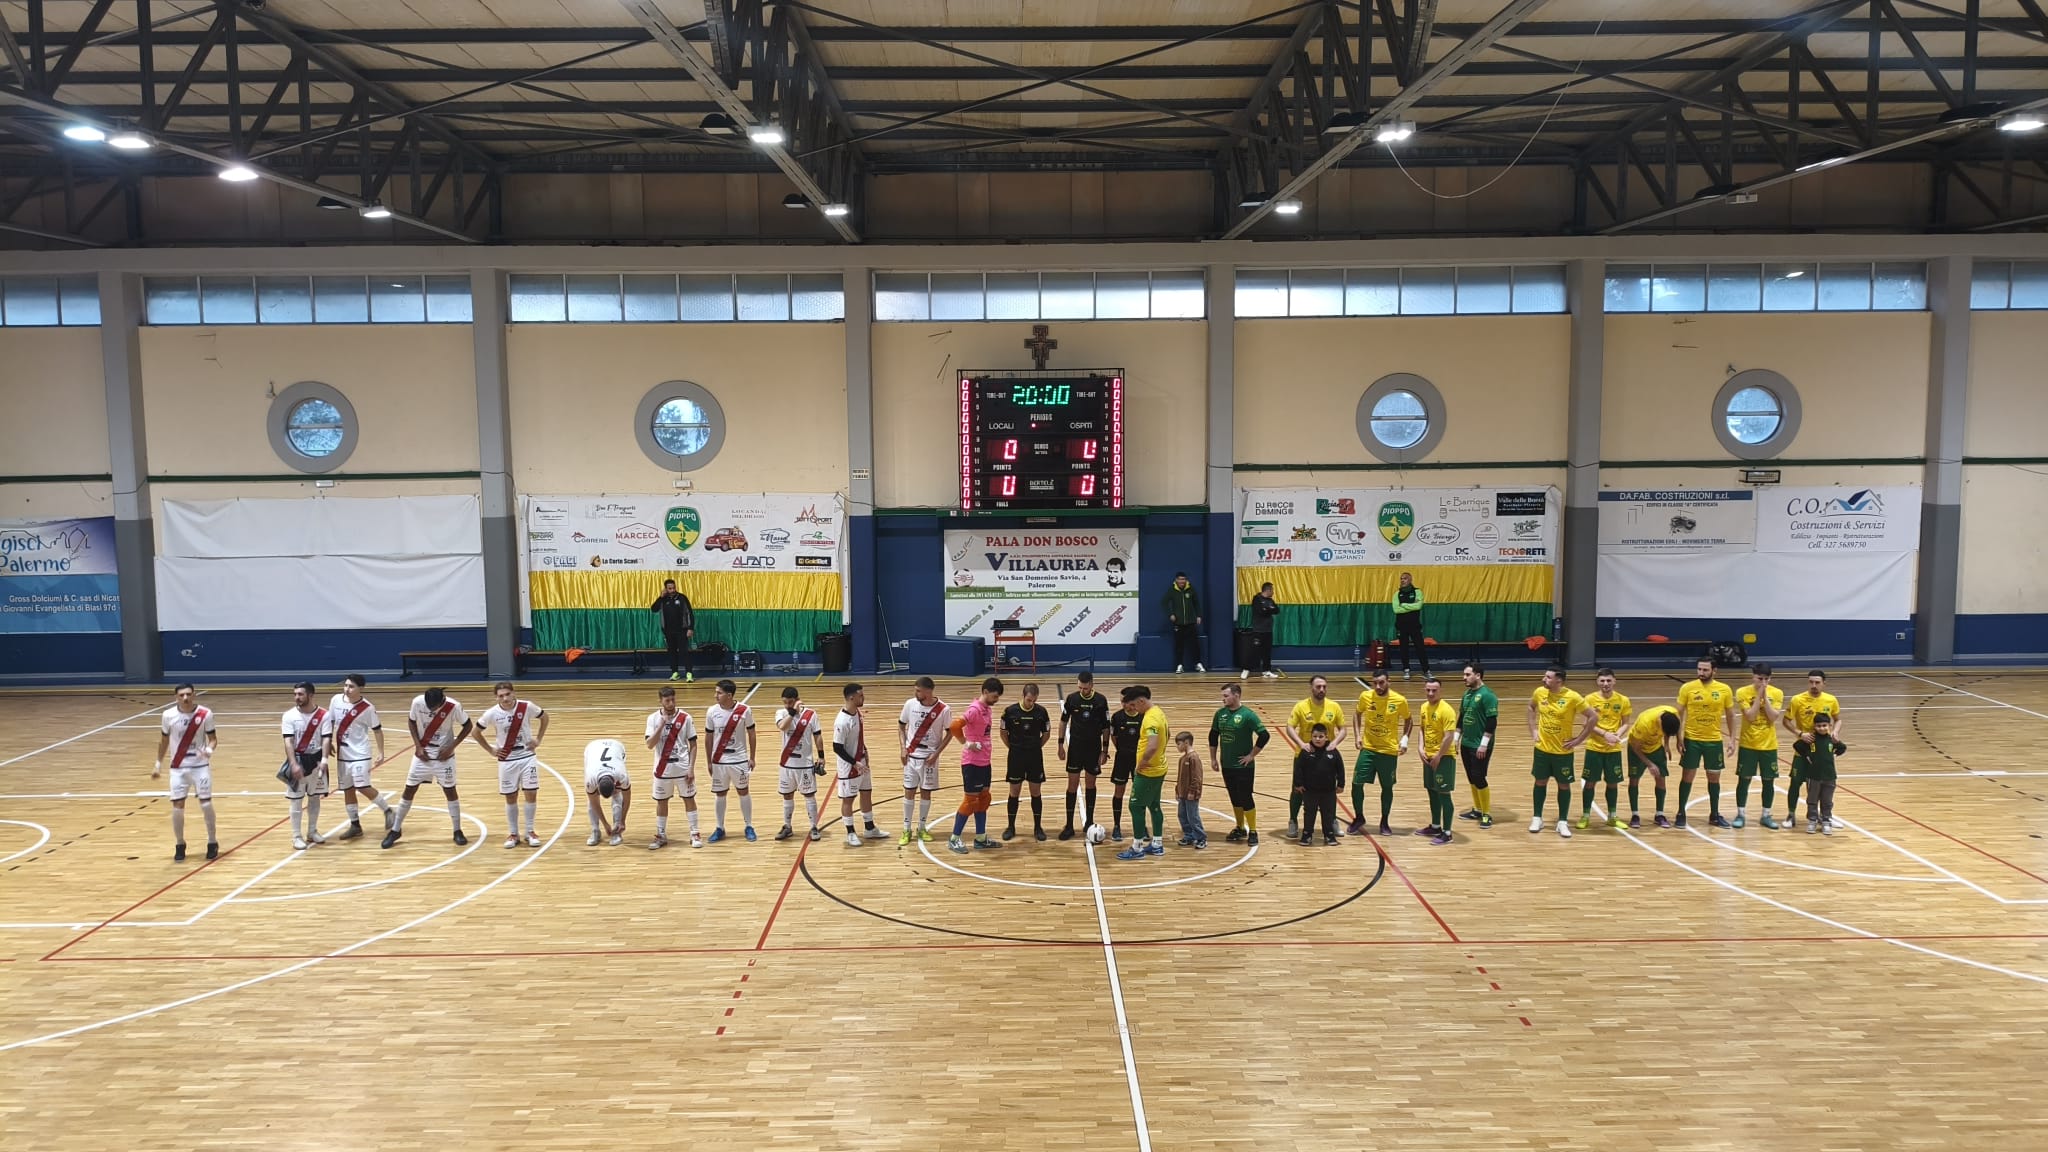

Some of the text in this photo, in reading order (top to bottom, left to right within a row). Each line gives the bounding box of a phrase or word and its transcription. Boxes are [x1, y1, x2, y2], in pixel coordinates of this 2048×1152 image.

[1012, 386, 1070, 404] 20:00
[1655, 492, 1712, 500] COSTRUZIONI
[1440, 497, 1490, 508] Le Barrique
[668, 513, 696, 521] PIOPPO
[1382, 508, 1410, 516] PIOPPO
[1790, 521, 1842, 530] Costruzioni
[1853, 520, 1886, 529] Servizi
[986, 536, 1020, 546] PALA
[1024, 536, 1051, 546] DON
[1055, 536, 1098, 546] BOSCO
[1266, 549, 1292, 559] SISA
[984, 553, 1099, 571] VILLAUREA
[36, 604, 76, 613] Evangelista
[957, 614, 982, 636] CALCIO
[1057, 606, 1091, 637] VOLLEY
[1103, 615, 1123, 634] DOLCE
[600, 748, 612, 761] 7
